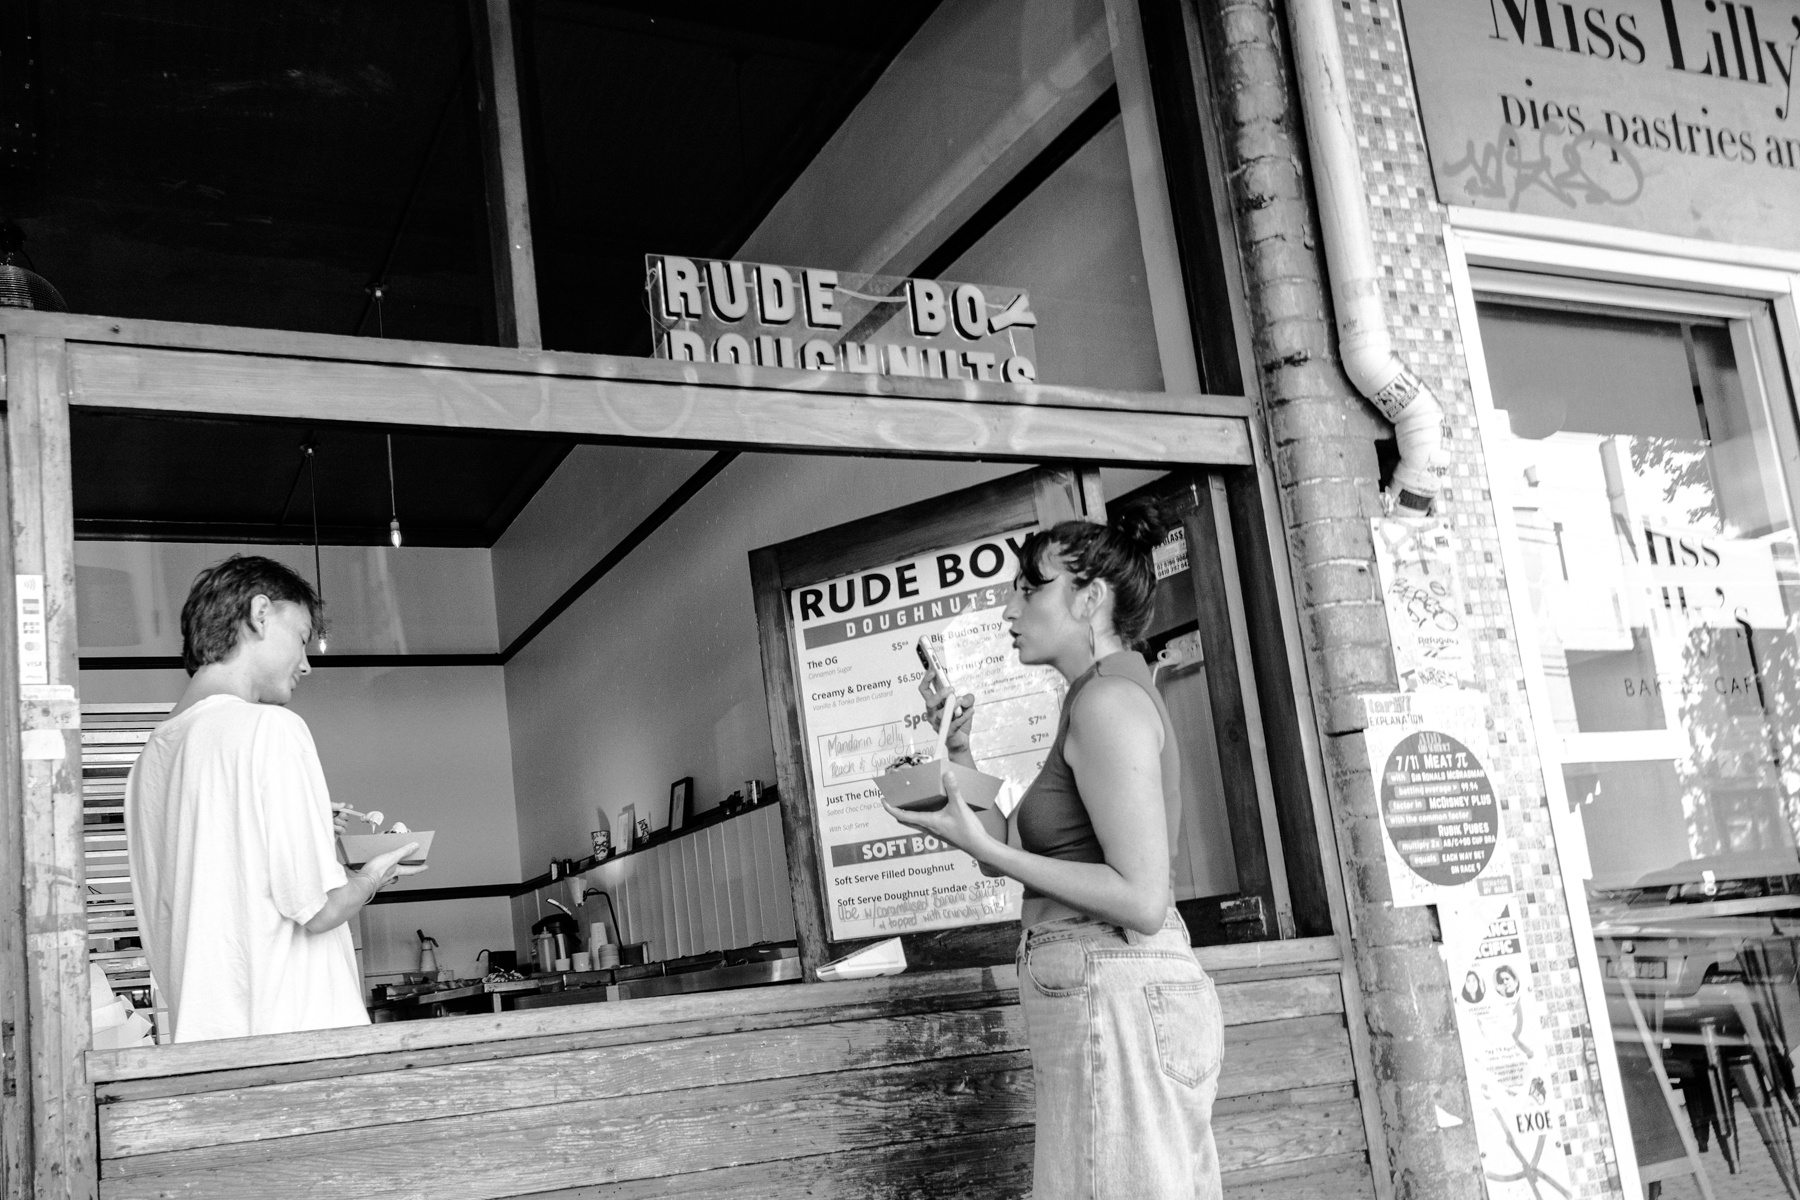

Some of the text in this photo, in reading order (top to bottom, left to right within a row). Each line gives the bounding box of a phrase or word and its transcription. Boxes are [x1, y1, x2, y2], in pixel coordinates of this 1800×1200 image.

[1489, 0, 1646, 65] Miss
[1601, 106, 1757, 165] pastries
[657, 255, 1038, 342] RUDE BOY
[800, 563, 920, 621] RUDE
[845, 588, 998, 638] DOUGHNUTS
[930, 632, 946, 644] Big
[980, 621, 1003, 633] Troy
[806, 660, 823, 670] The
[824, 656, 838, 667] OG
[808, 664, 853, 680] Cinnamon Sugar
[956, 659, 983, 670] Fruity
[985, 654, 1005, 664] One
[811, 688, 846, 702] Creamy
[847, 685, 855, 694] &
[856, 678, 892, 692] Dreamy
[812, 700, 832, 711] Vanilla
[855, 694, 871, 704] Bean
[871, 689, 894, 700] Custard
[828, 723, 905, 757] Mandarin Jelly
[830, 760, 857, 777] Peach
[1390, 772, 1406, 783] with
[826, 795, 844, 807] Just
[844, 791, 862, 802] The
[1398, 785, 1425, 796] batting
[827, 808, 845, 817] Salted
[845, 805, 859, 814] Choc
[859, 803, 873, 812] Chip
[1392, 800, 1414, 811] factor
[1414, 799, 1423, 809] in
[1470, 793, 1492, 807] PLUS
[829, 821, 869, 834] With Soft Serve
[1389, 810, 1470, 826] with the common factor
[861, 838, 907, 860] SOFT
[1401, 841, 1430, 852] multiply
[1430, 840, 1441, 849] 2x
[1414, 855, 1438, 865] equals
[1441, 853, 1459, 864] EACH
[1458, 851, 1473, 862] WAY
[834, 862, 955, 886] Soft Serve Filled Doughnut
[837, 878, 1006, 907] Soft Serve Doughnut Sundae $12.50
[930, 891, 967, 909] Banana
[888, 912, 918, 930] topped
[922, 908, 941, 923] with
[942, 904, 980, 921] crunchy
[1516, 1110, 1554, 1134] EXOE
